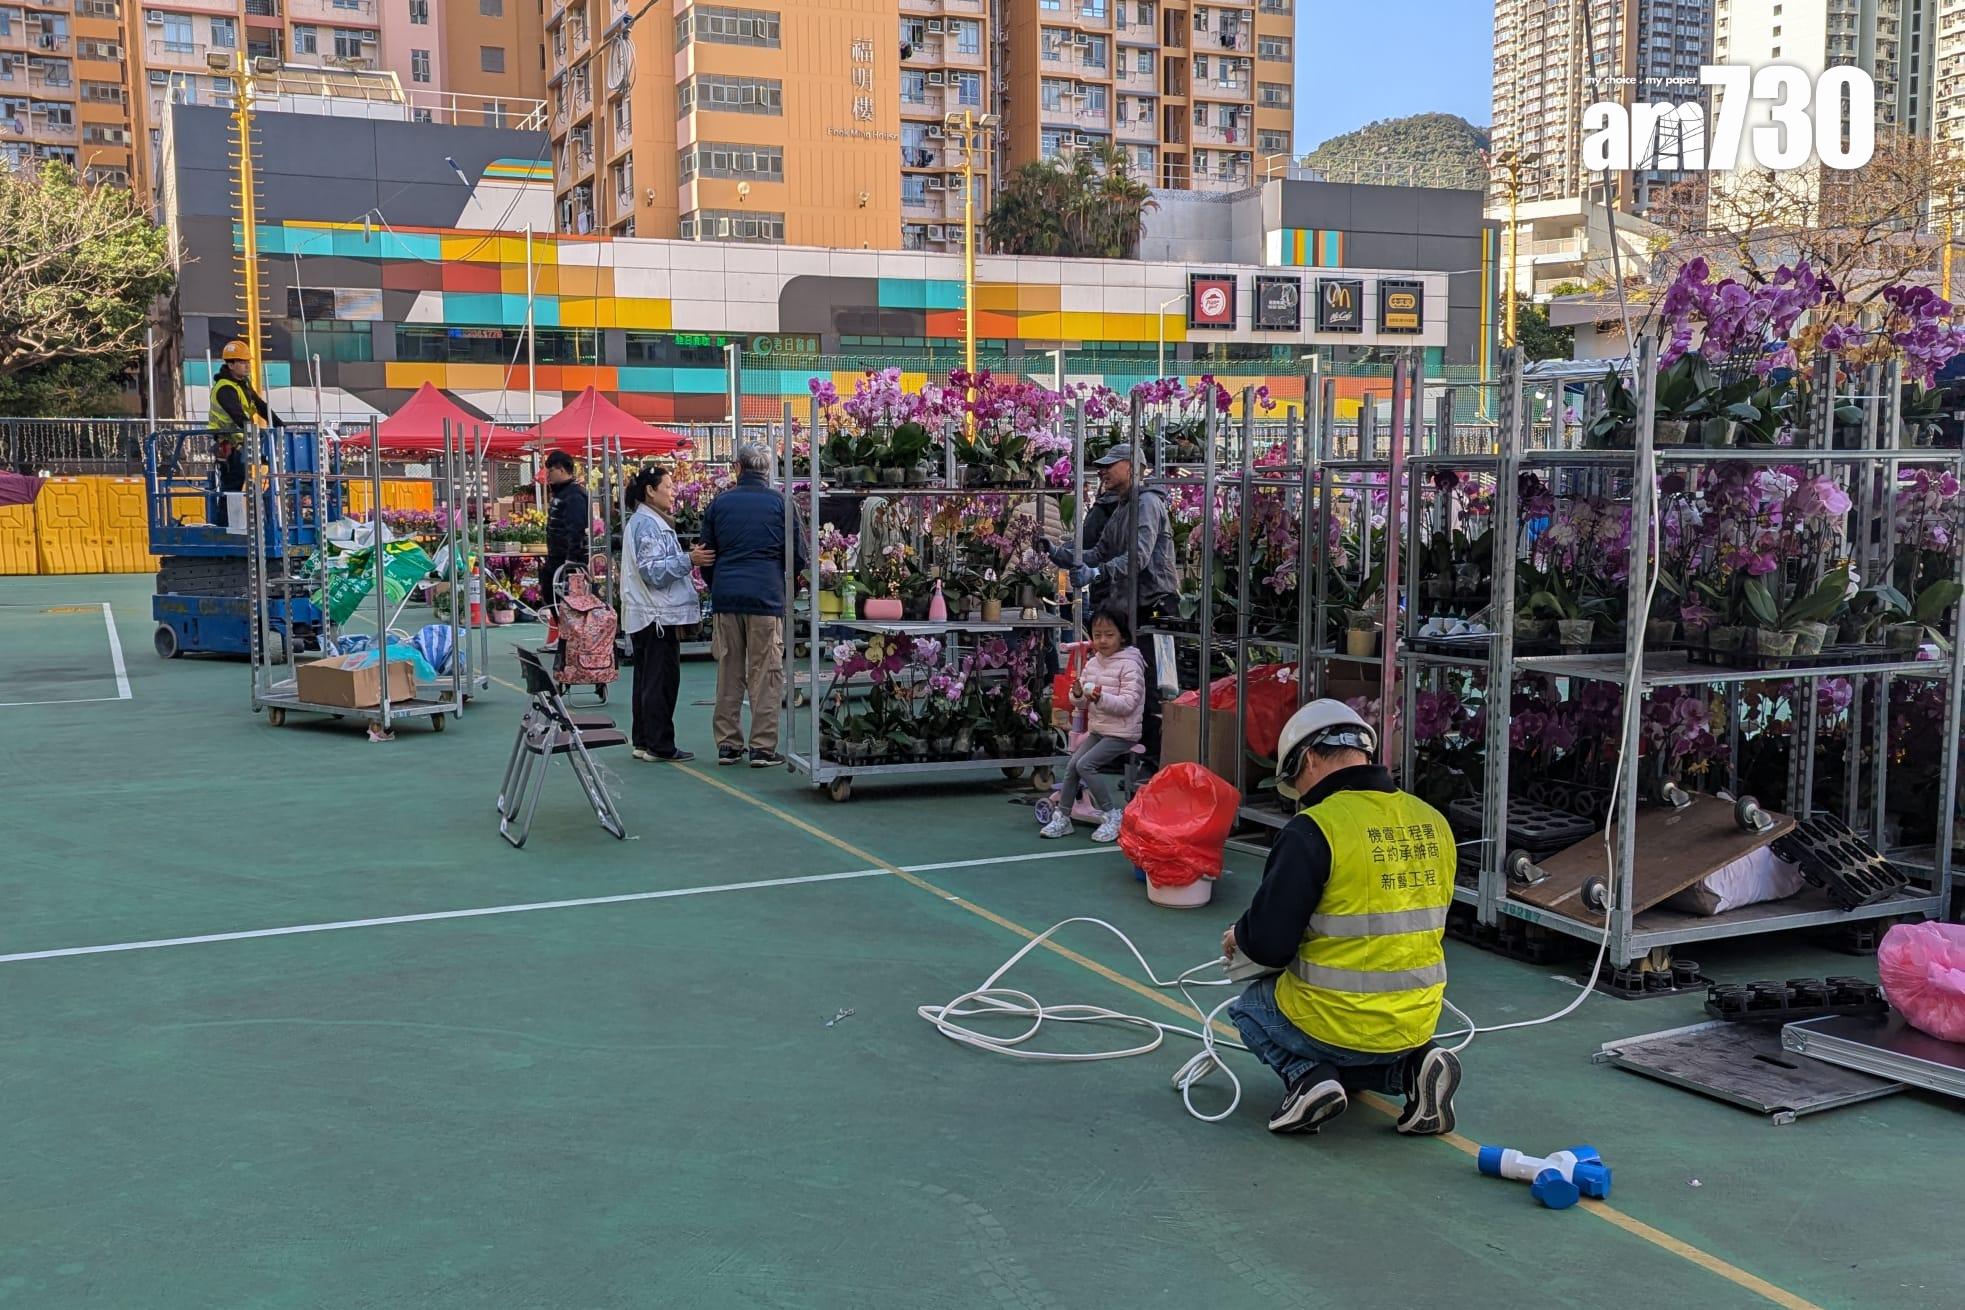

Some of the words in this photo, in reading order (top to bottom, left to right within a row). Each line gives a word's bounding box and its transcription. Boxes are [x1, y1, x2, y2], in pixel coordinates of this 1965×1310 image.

[851, 38, 874, 122] 福明樓
[872, 131, 898, 141] House
[1367, 823, 1436, 843] 機電工程署
[1372, 842, 1440, 863] 合約承辦商
